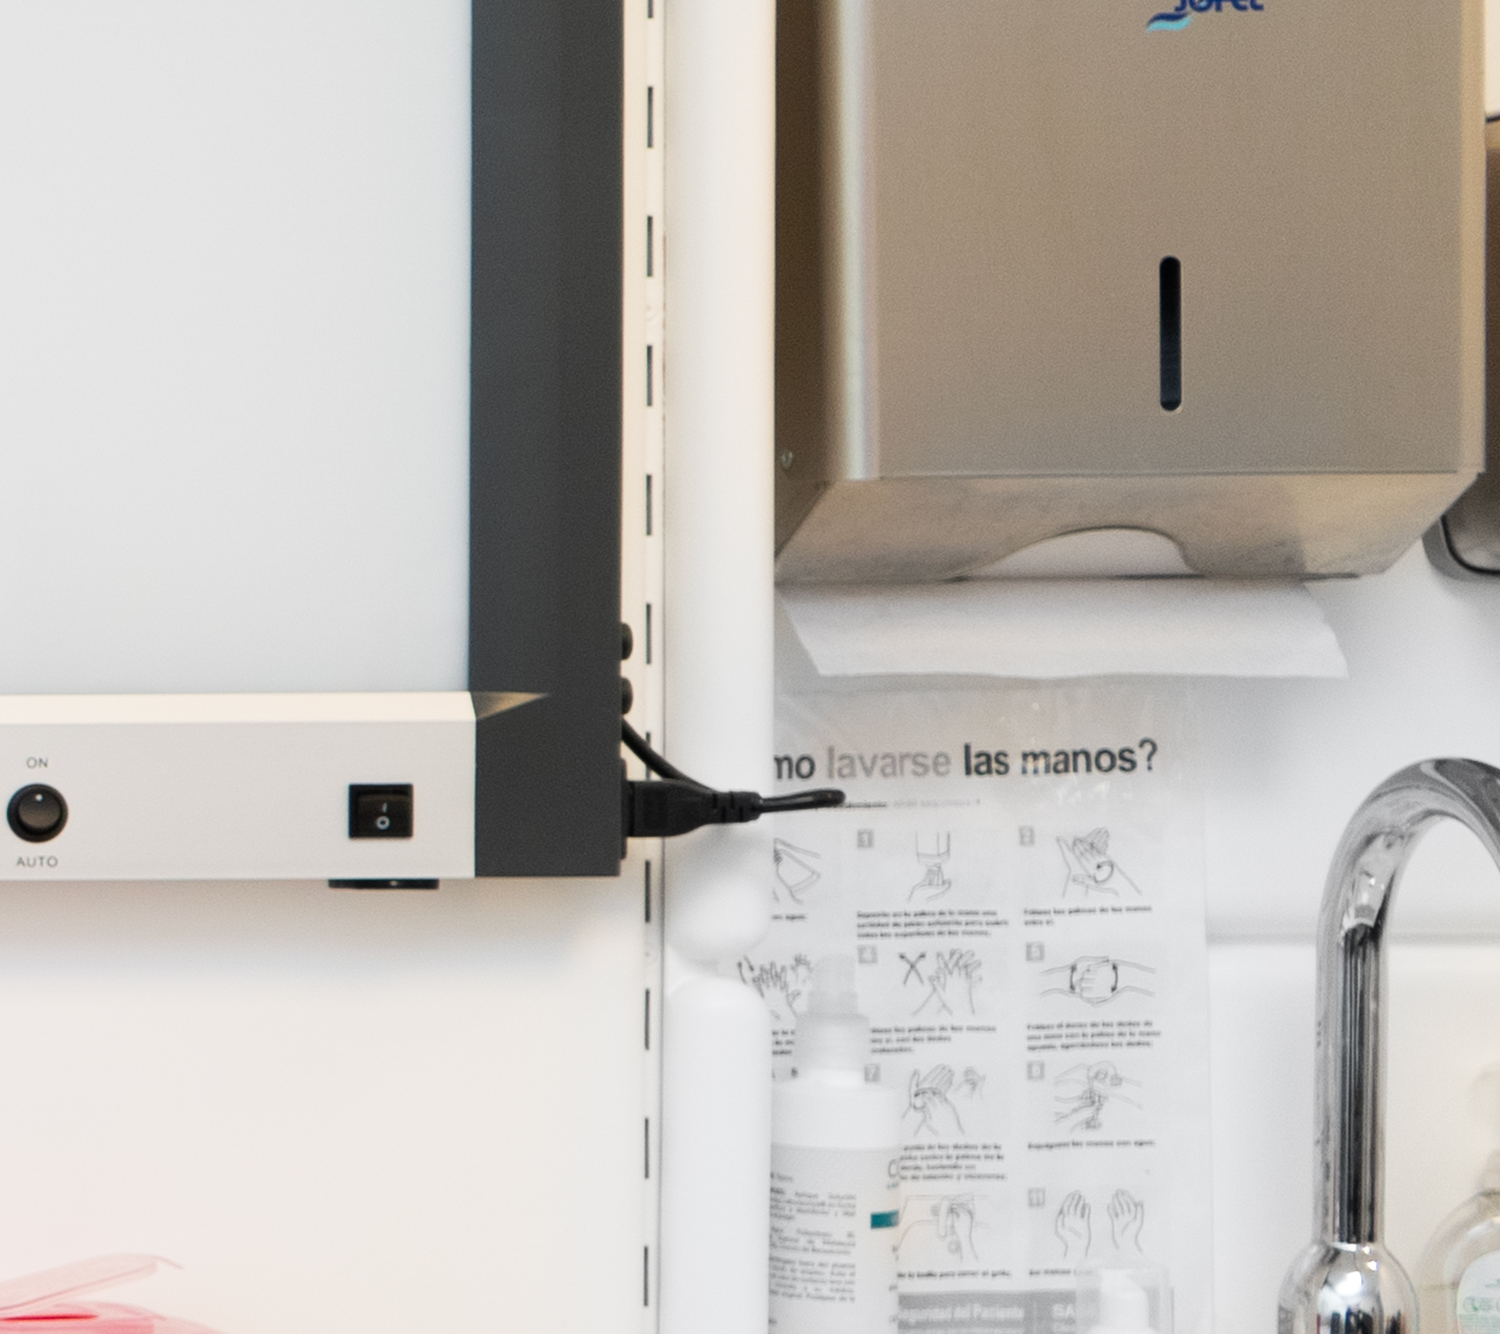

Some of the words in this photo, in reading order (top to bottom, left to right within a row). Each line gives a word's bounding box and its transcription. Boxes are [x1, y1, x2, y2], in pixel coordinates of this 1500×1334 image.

[26, 757, 49, 769] ON
[827, 745, 952, 779] lavarse
[964, 742, 1011, 777] las
[1020, 738, 1158, 776] manos?
[16, 855, 59, 869] AUTO
